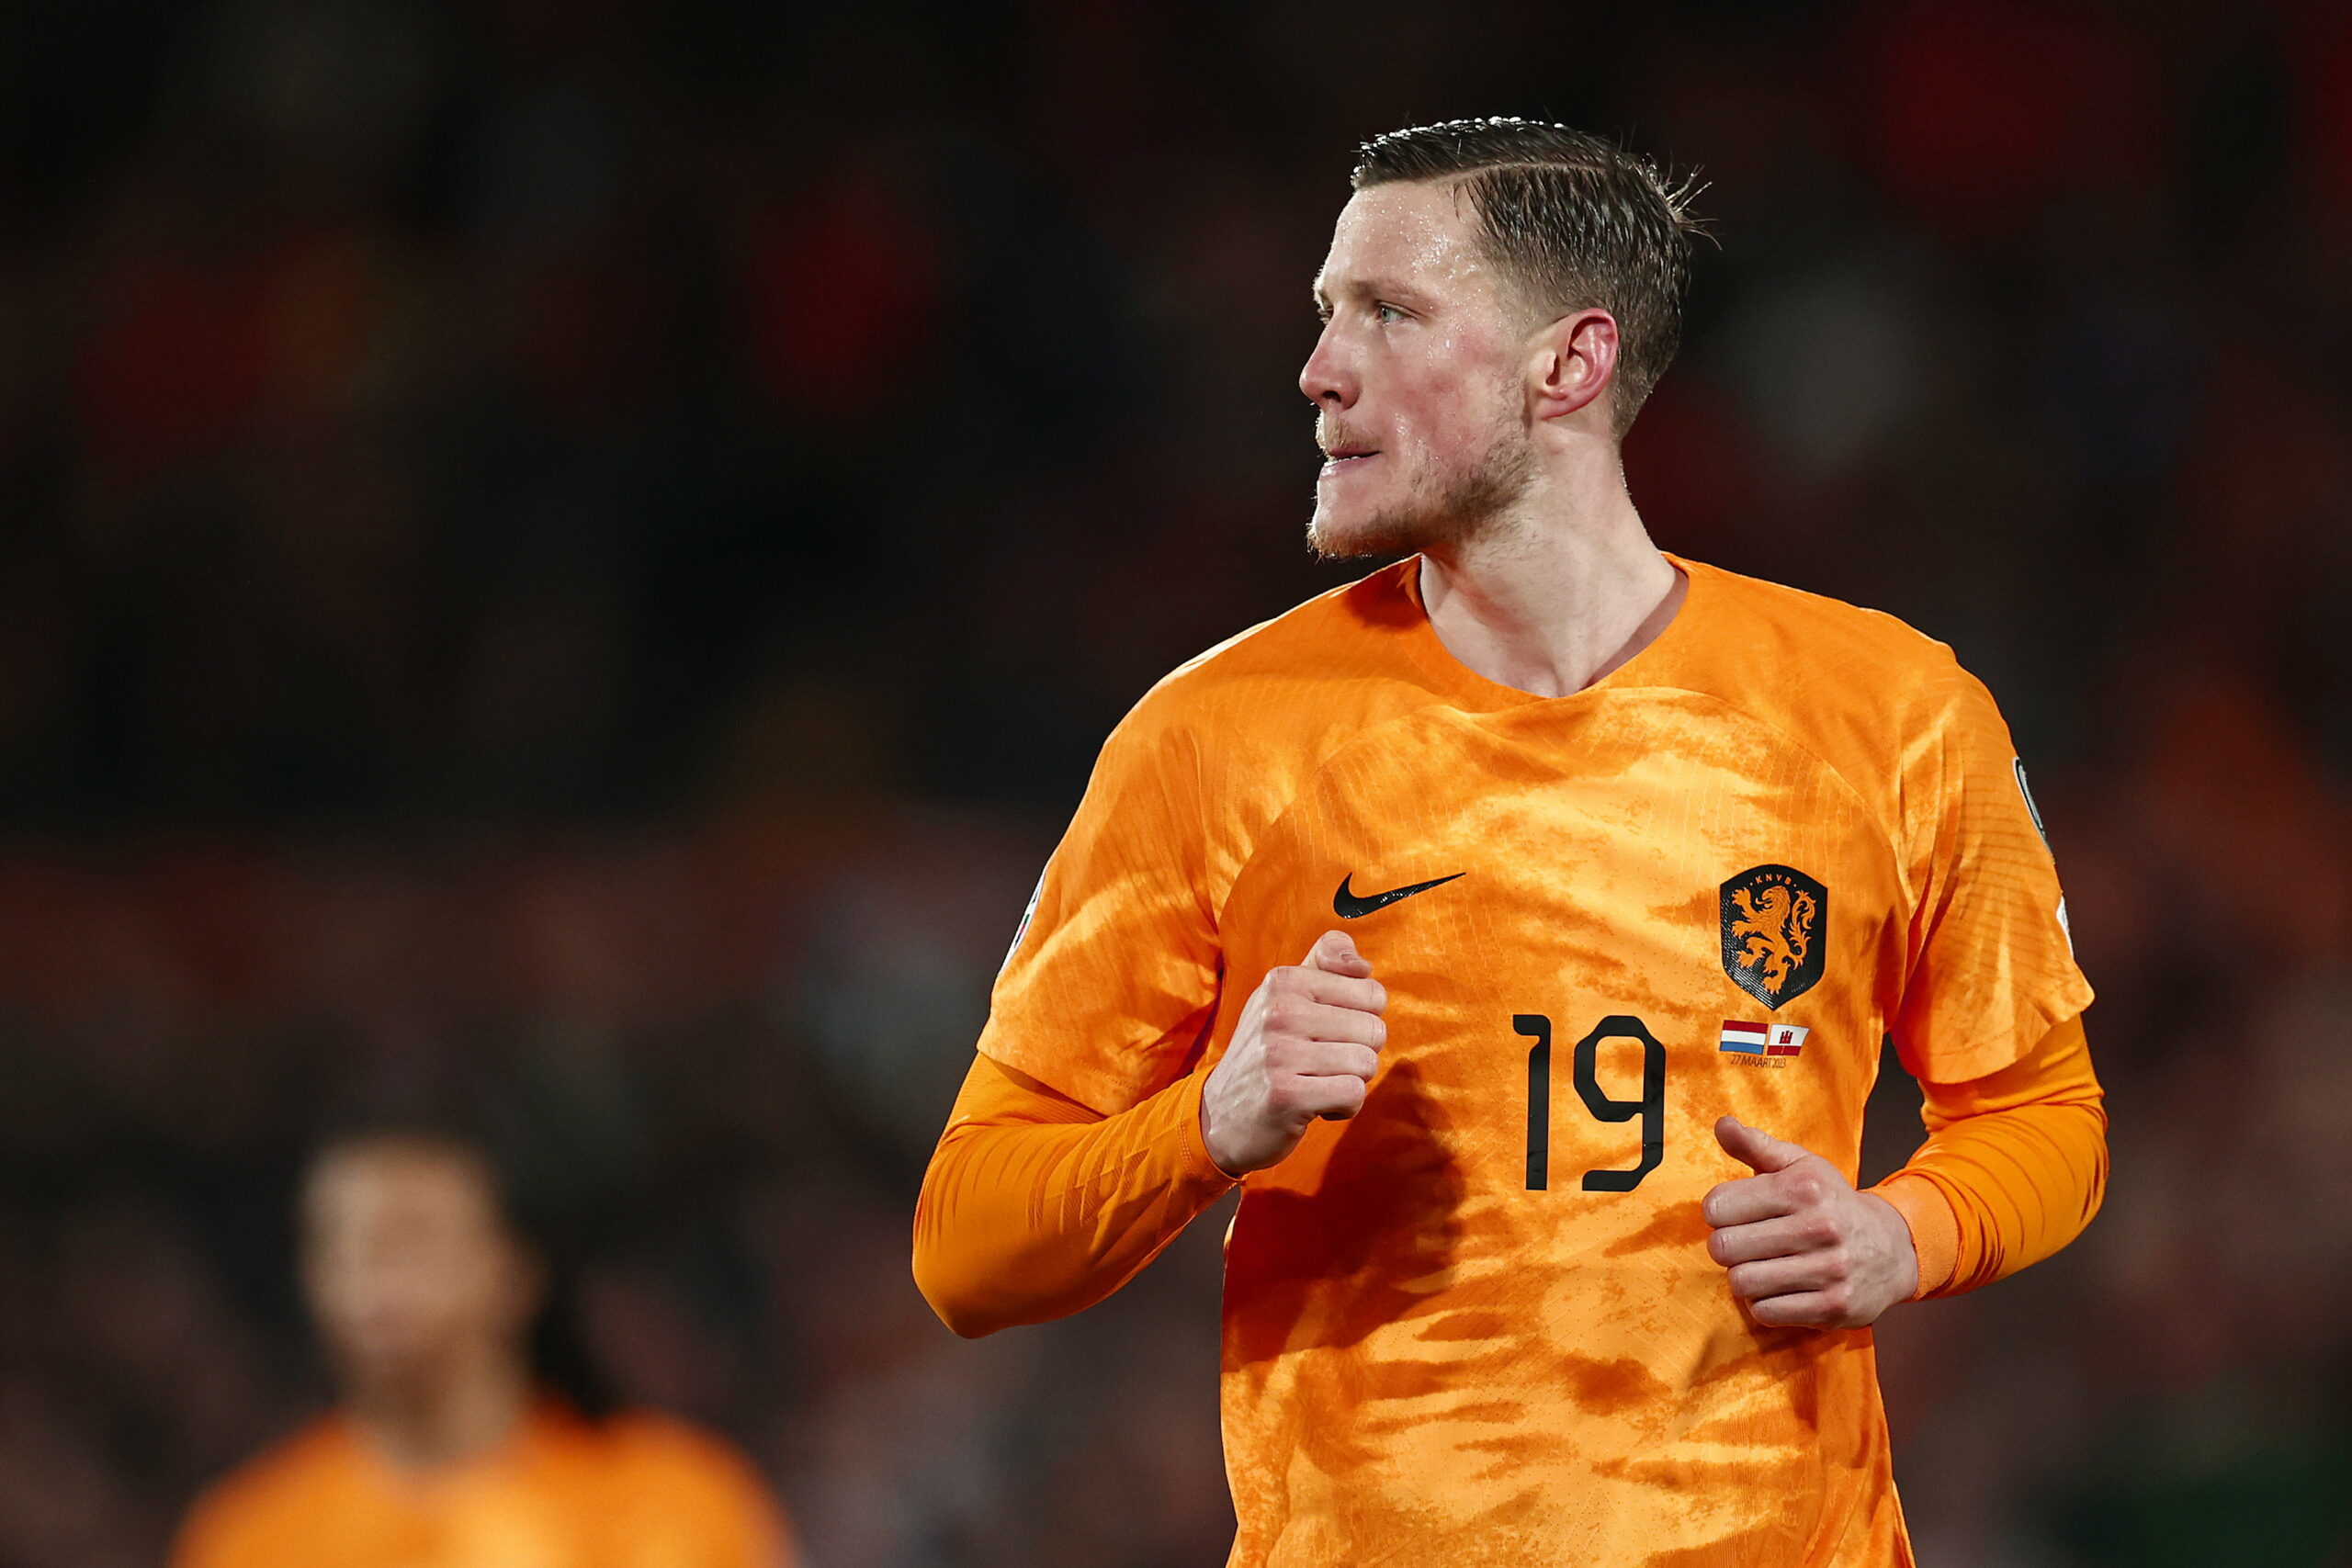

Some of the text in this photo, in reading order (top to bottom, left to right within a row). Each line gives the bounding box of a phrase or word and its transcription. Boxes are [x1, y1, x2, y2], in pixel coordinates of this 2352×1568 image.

[1755, 874, 1792, 885] KNVB
[1730, 1055, 1741, 1065] 27
[1740, 1055, 1771, 1067] MAART
[1512, 1014, 1666, 1192] 19
